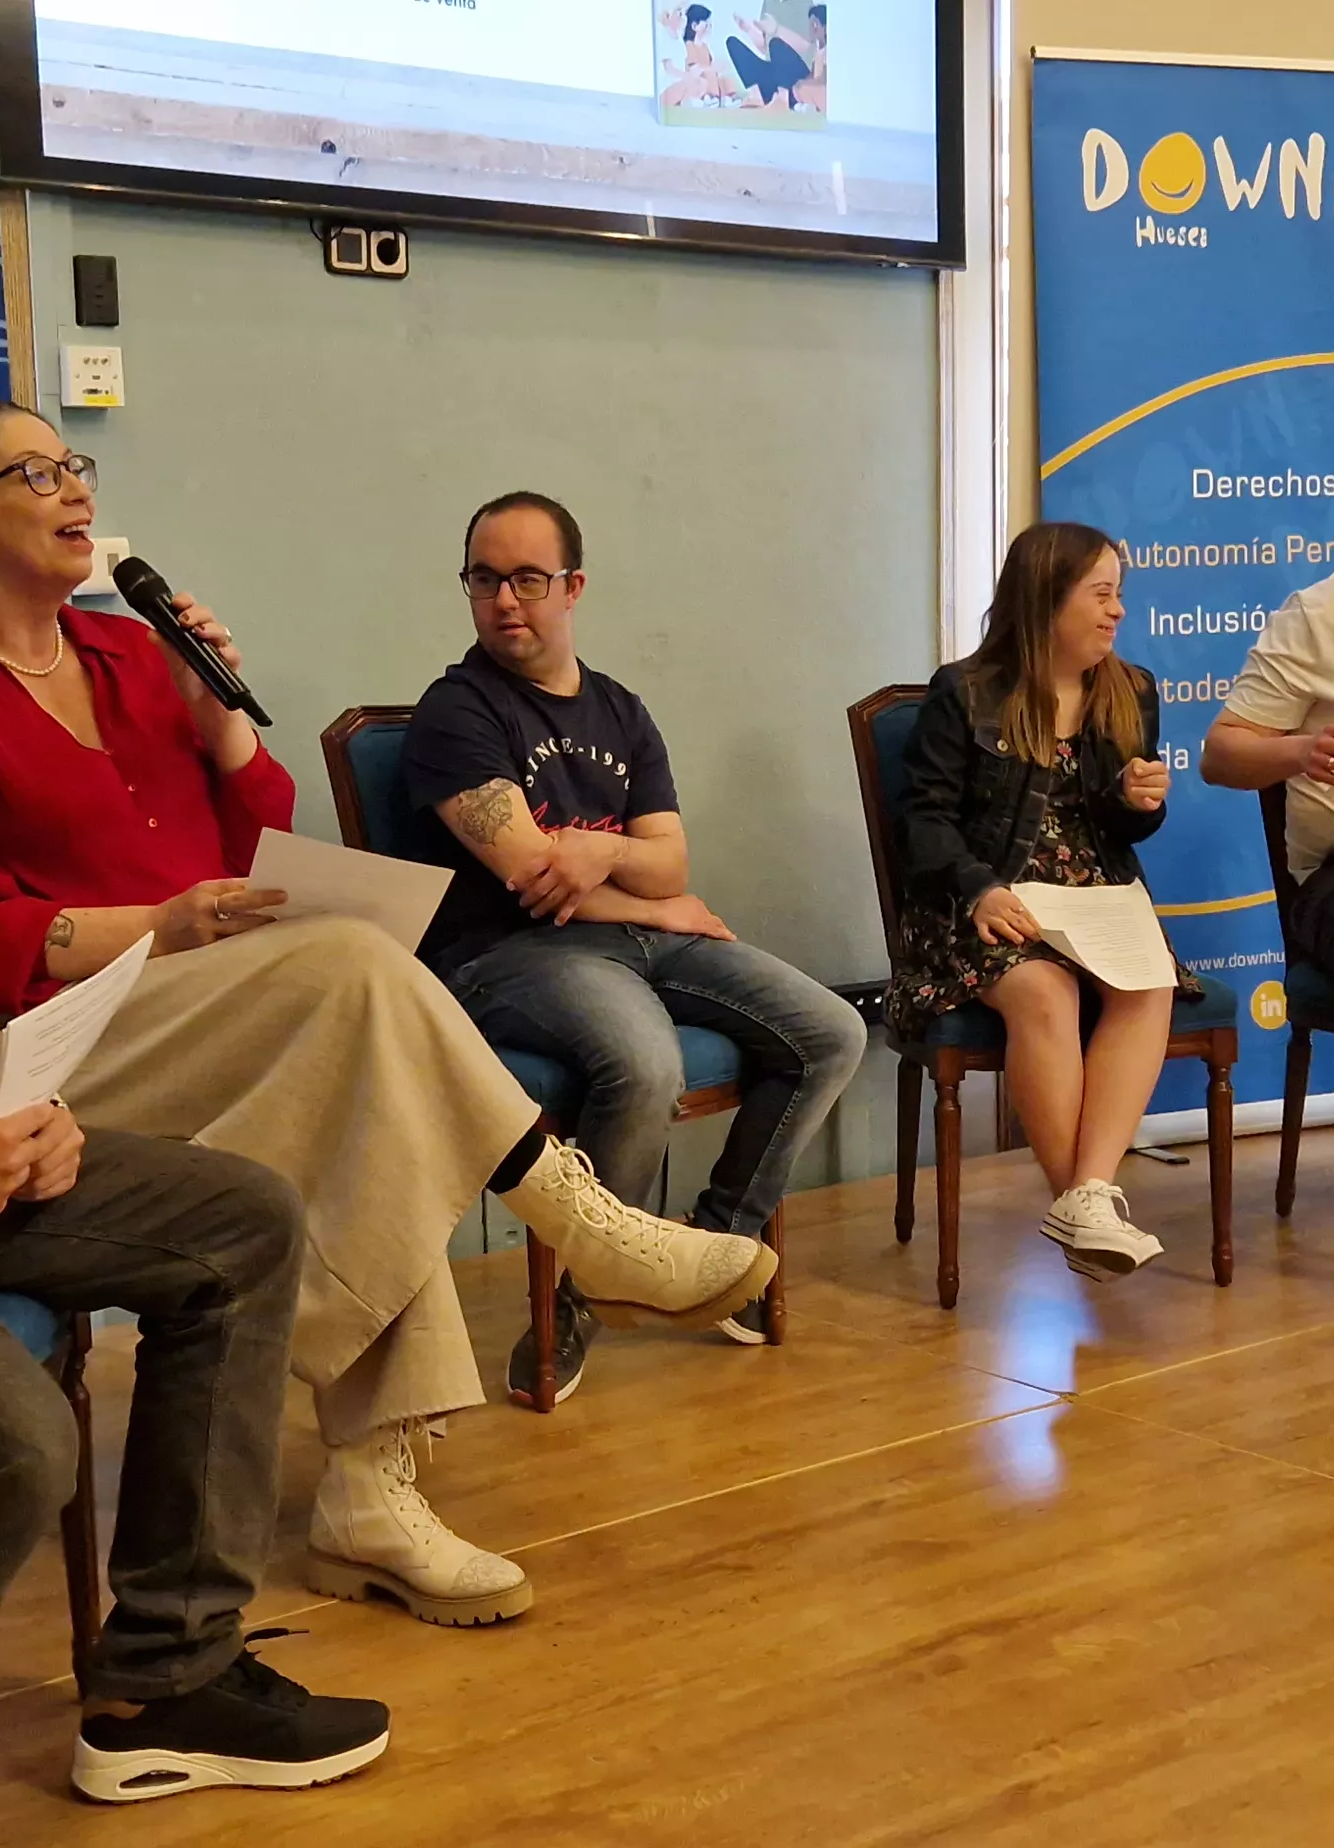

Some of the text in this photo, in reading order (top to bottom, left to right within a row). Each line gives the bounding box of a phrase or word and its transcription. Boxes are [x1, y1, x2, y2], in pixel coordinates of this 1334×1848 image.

[1082, 127, 1325, 221] DOWN
[1117, 537, 1276, 568] Autonomía
[1149, 604, 1277, 636] Inclusió
[1155, 672, 1239, 703] tode
[1185, 949, 1285, 972] www.downhu
[1259, 993, 1282, 1017] in
